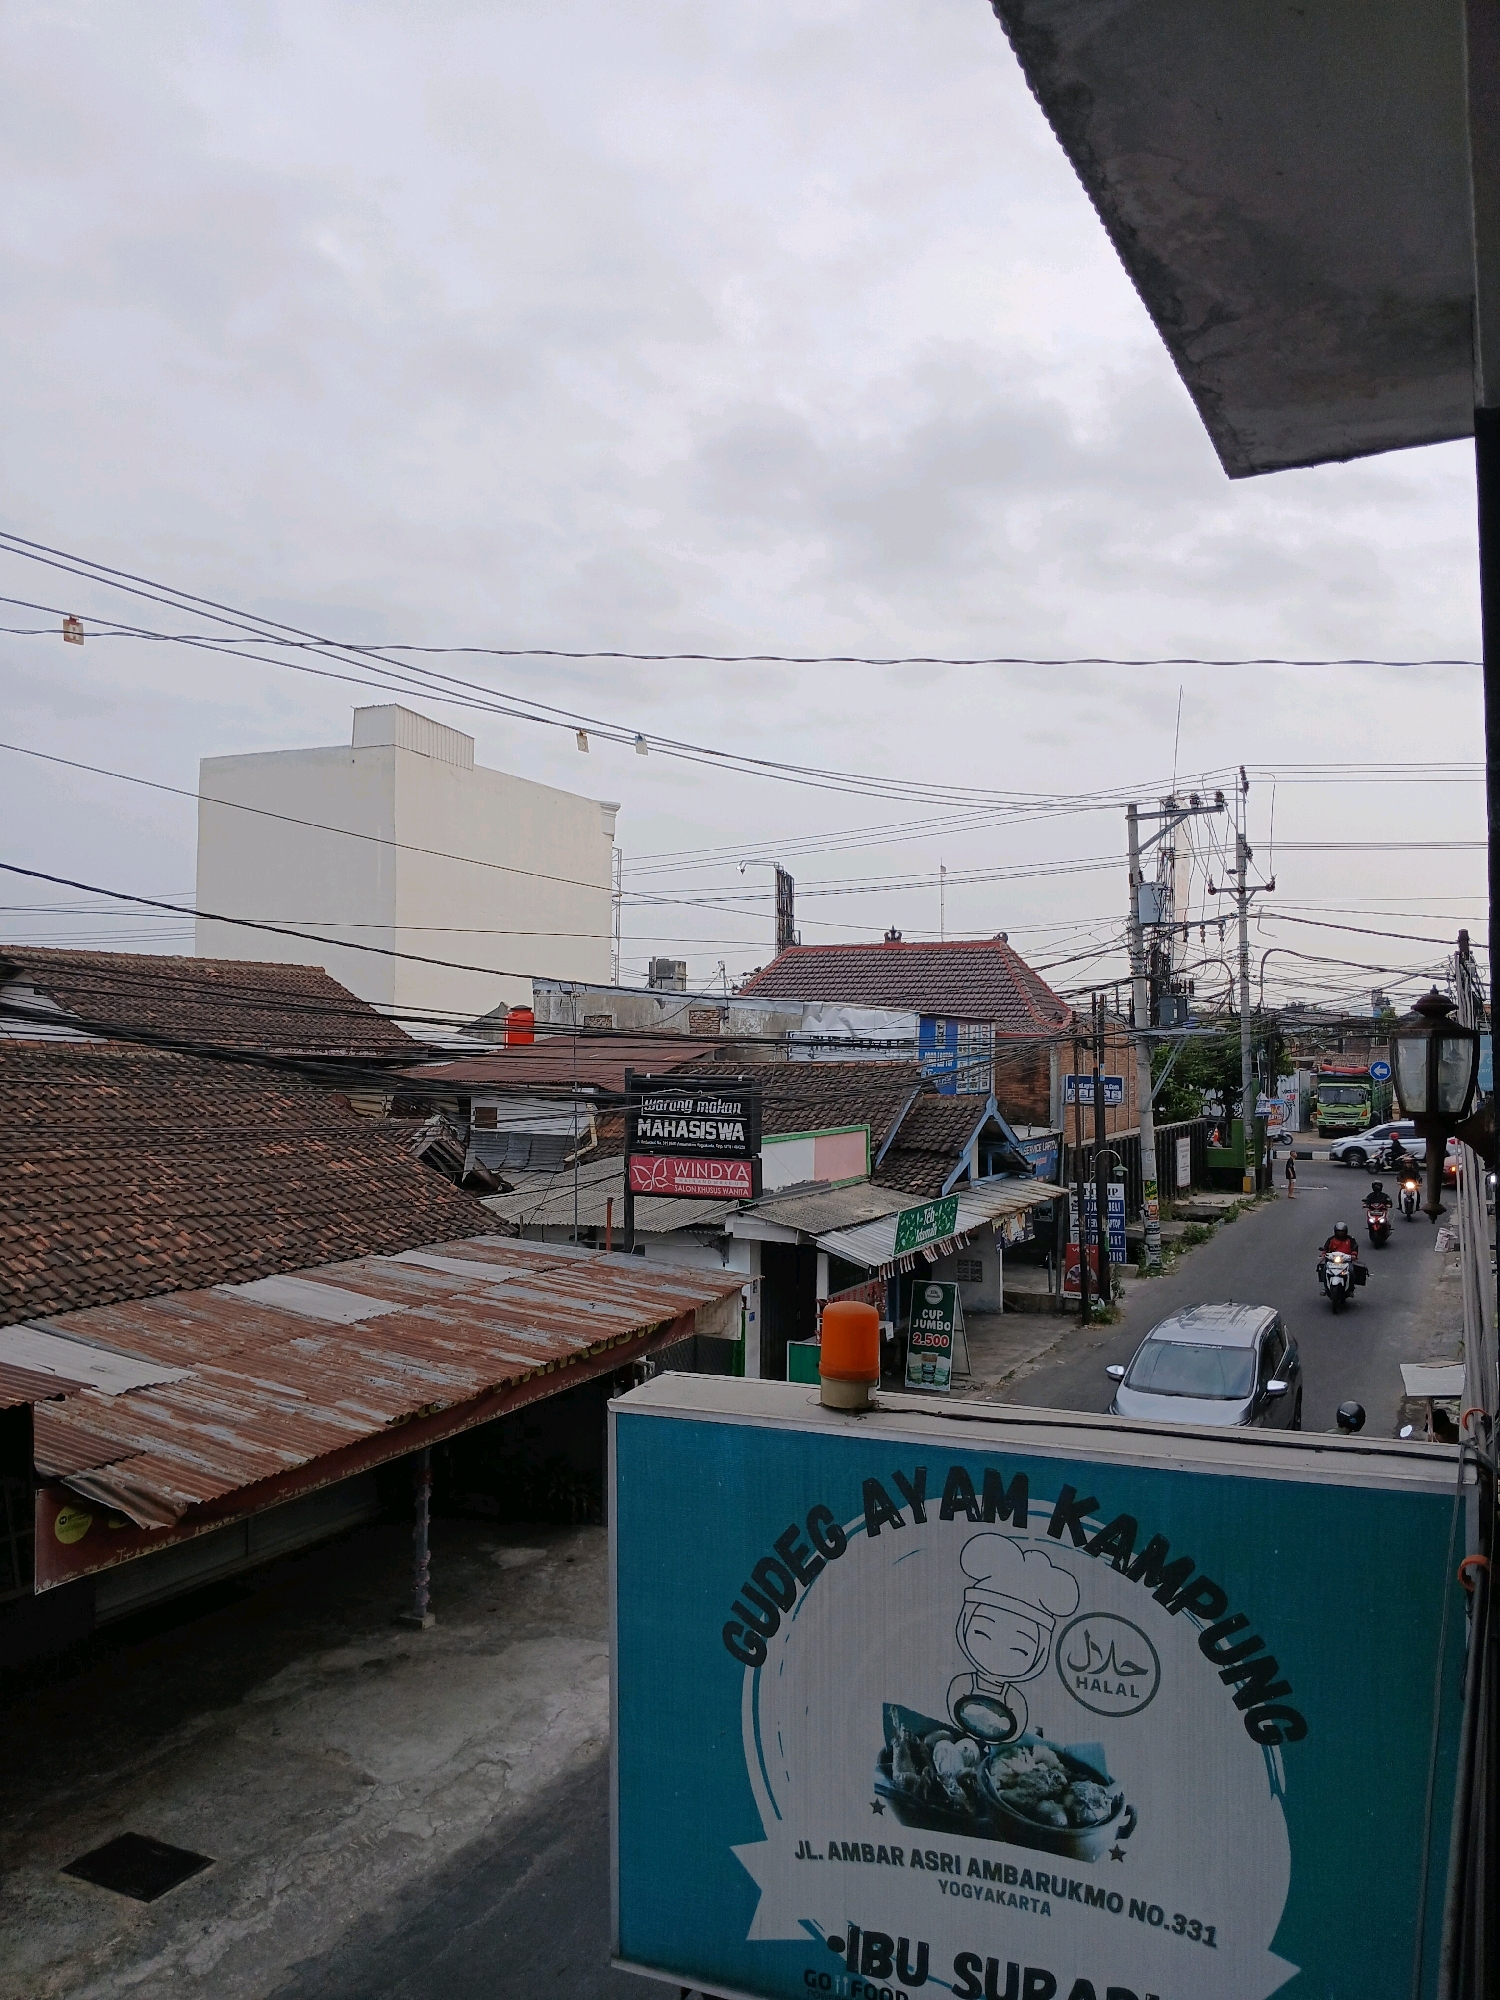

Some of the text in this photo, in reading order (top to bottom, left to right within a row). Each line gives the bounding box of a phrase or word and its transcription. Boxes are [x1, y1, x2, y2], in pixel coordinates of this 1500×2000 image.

[638, 1119, 744, 1141] MAHASISWA
[1023, 1143, 1042, 1155] SERVICE
[674, 1161, 750, 1180] WINDYA
[674, 1185, 749, 1196] SALON KHUSUS WANITA
[913, 1319, 951, 1331] JUMBO
[922, 1309, 943, 1320] CUP
[912, 1332, 949, 1347] 2.500
[722, 1466, 1308, 1745] GUDEG AYAM KAMPUNG
[1067, 1629, 1148, 1676] حلال
[1076, 1676, 1139, 1698] HALAL
[795, 1840, 1219, 1949] JL. AMBAR ASRI AMBARUKMO NO.331
[938, 1879, 1052, 1917] YOGYAKARTA
[804, 1969, 832, 1990] GO
